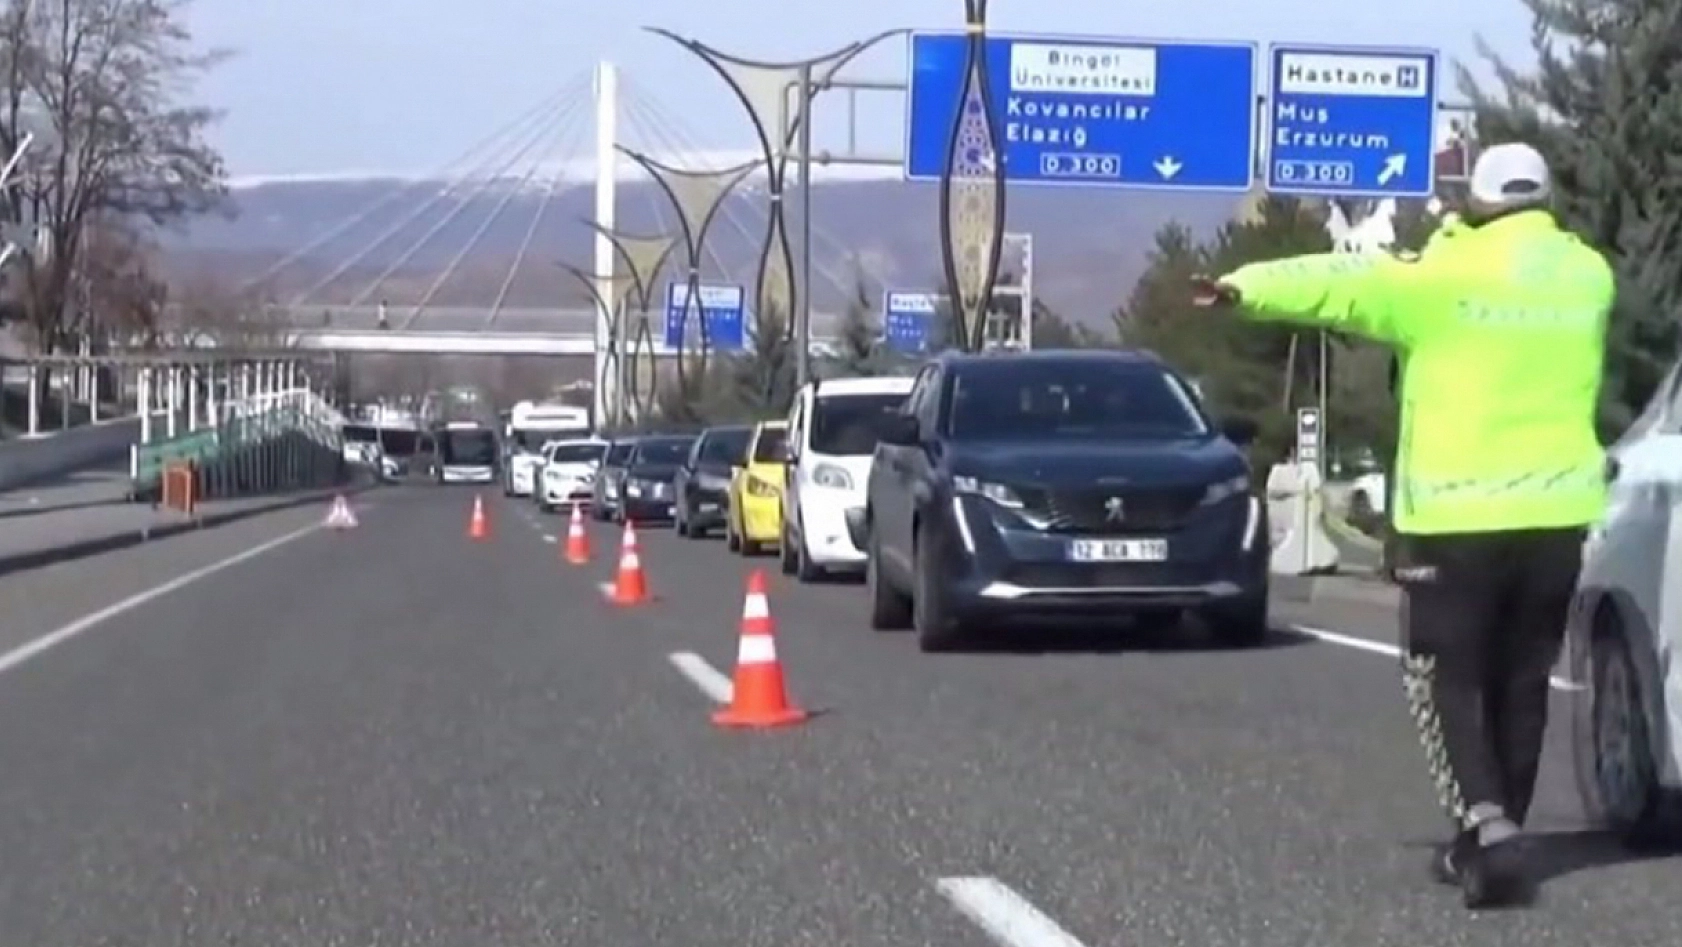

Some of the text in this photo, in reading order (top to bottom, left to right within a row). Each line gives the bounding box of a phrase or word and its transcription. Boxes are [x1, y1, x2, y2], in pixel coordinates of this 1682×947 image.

[1288, 65, 1392, 84] Hastane
[1007, 97, 1149, 120] Kovancılar
[1278, 101, 1328, 124] Muş
[1007, 122, 1087, 148] Elazığ
[1277, 127, 1389, 149] Erzurum
